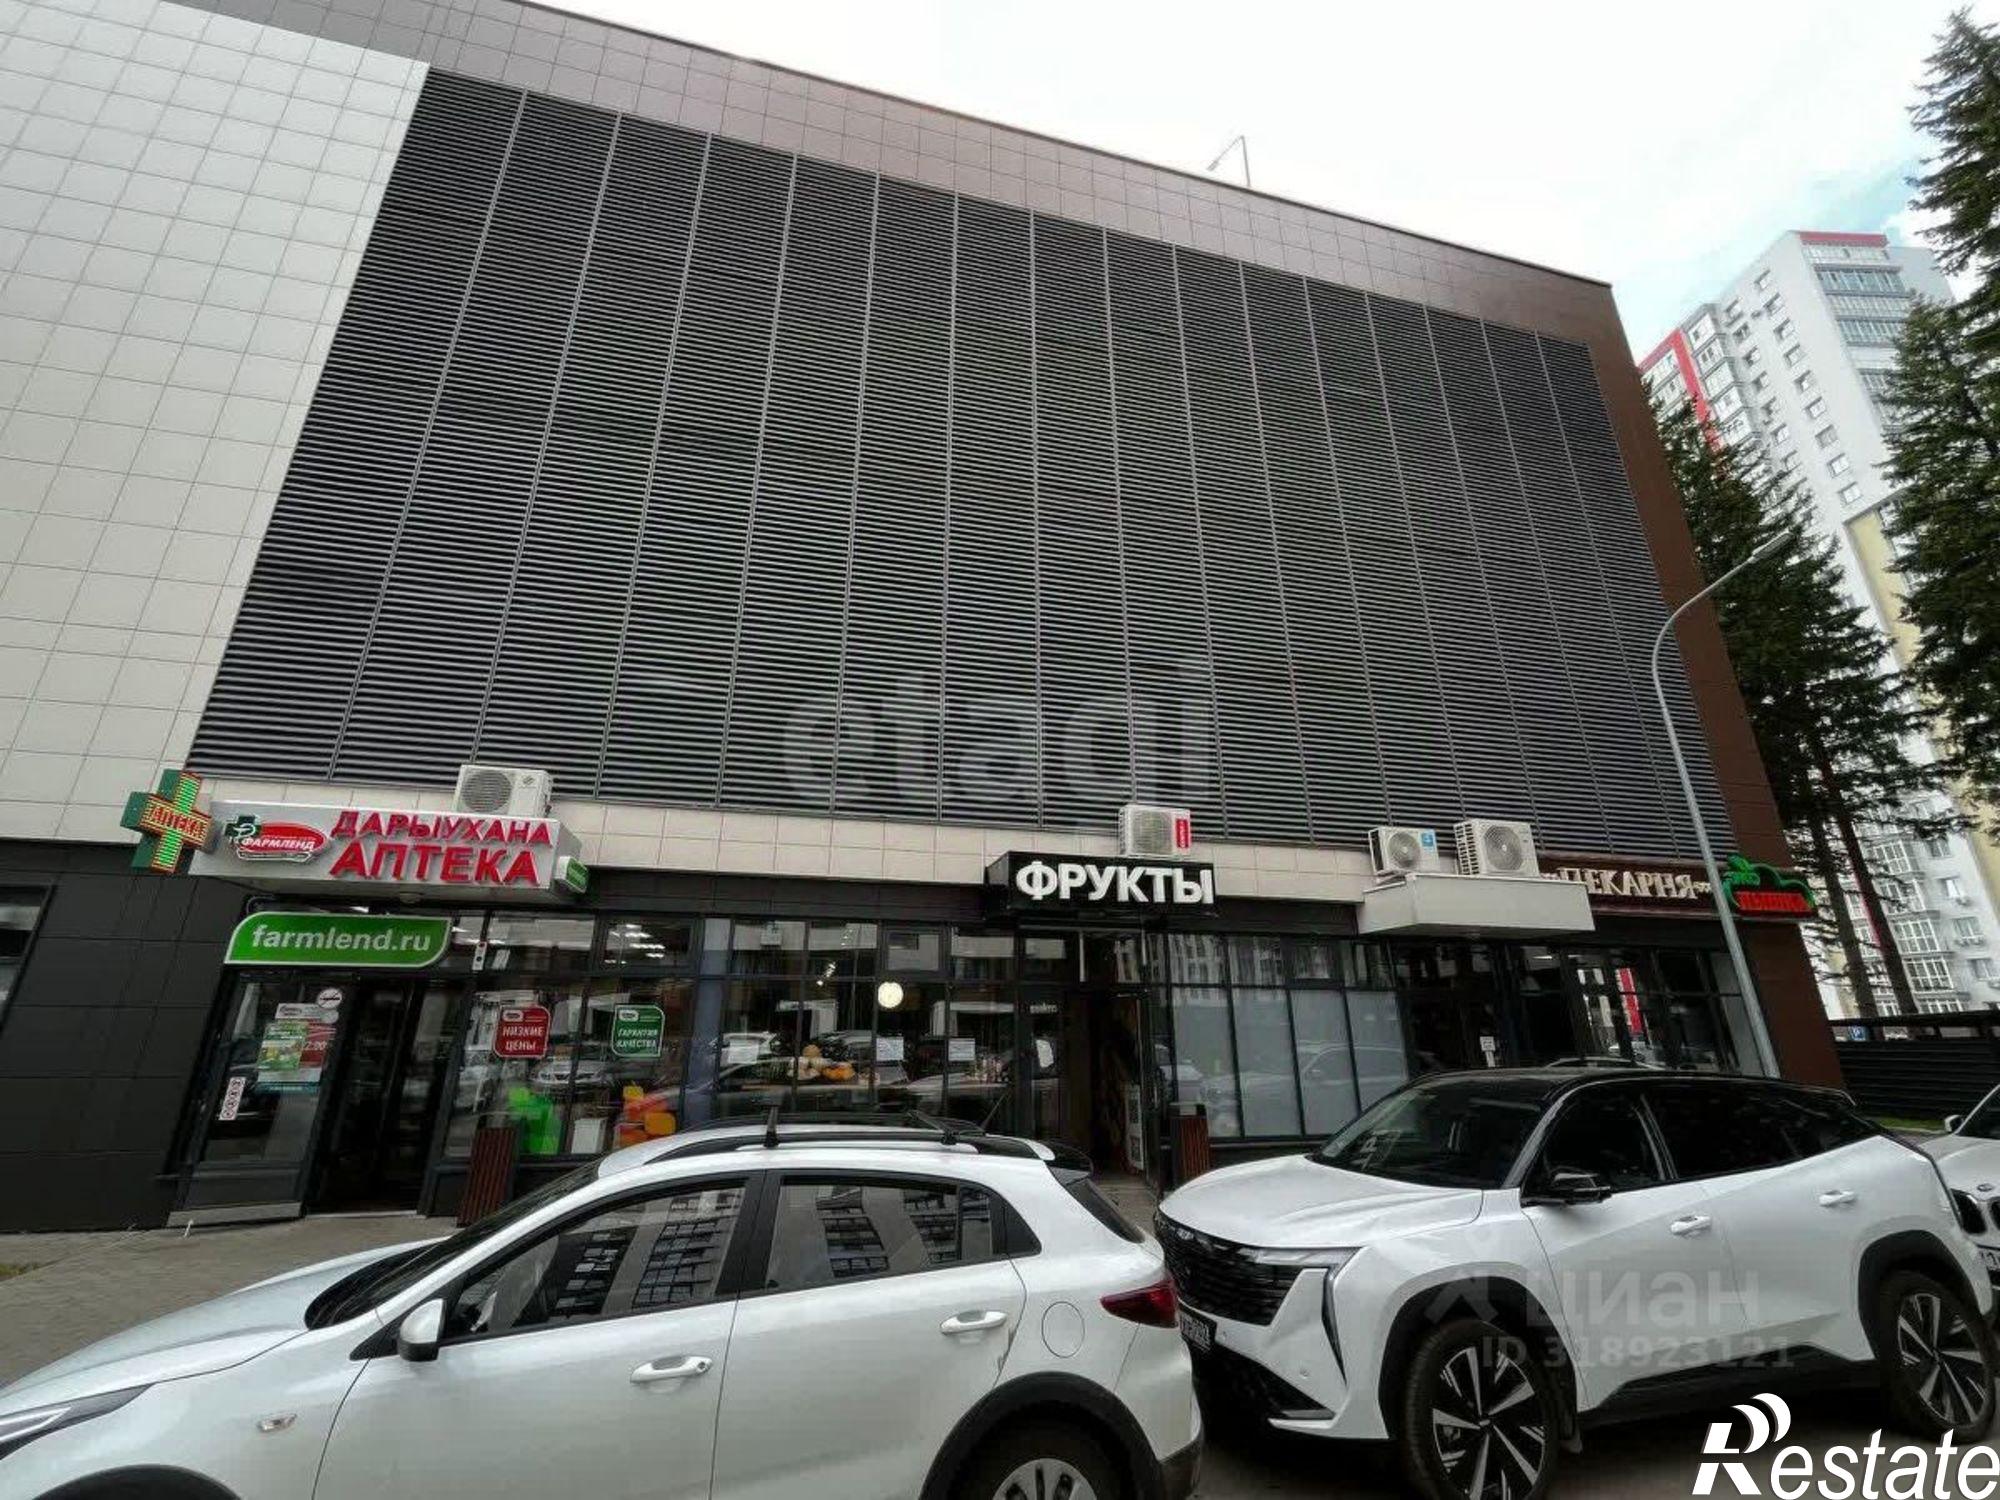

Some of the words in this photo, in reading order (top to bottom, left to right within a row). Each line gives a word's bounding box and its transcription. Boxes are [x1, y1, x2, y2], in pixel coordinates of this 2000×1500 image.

[151, 806, 204, 841] АПТЕКА
[330, 811, 552, 845] ДАРЫУХАНА
[241, 837, 316, 852] ФАРМЛЕНД
[329, 841, 540, 887] АПТЕКА
[1016, 861, 1214, 904] ФРУКТЫ
[252, 924, 430, 951] farmlend.ru
[502, 1025, 544, 1037] НИЗКИЕ
[505, 1040, 537, 1051] ЦЕНЫ
